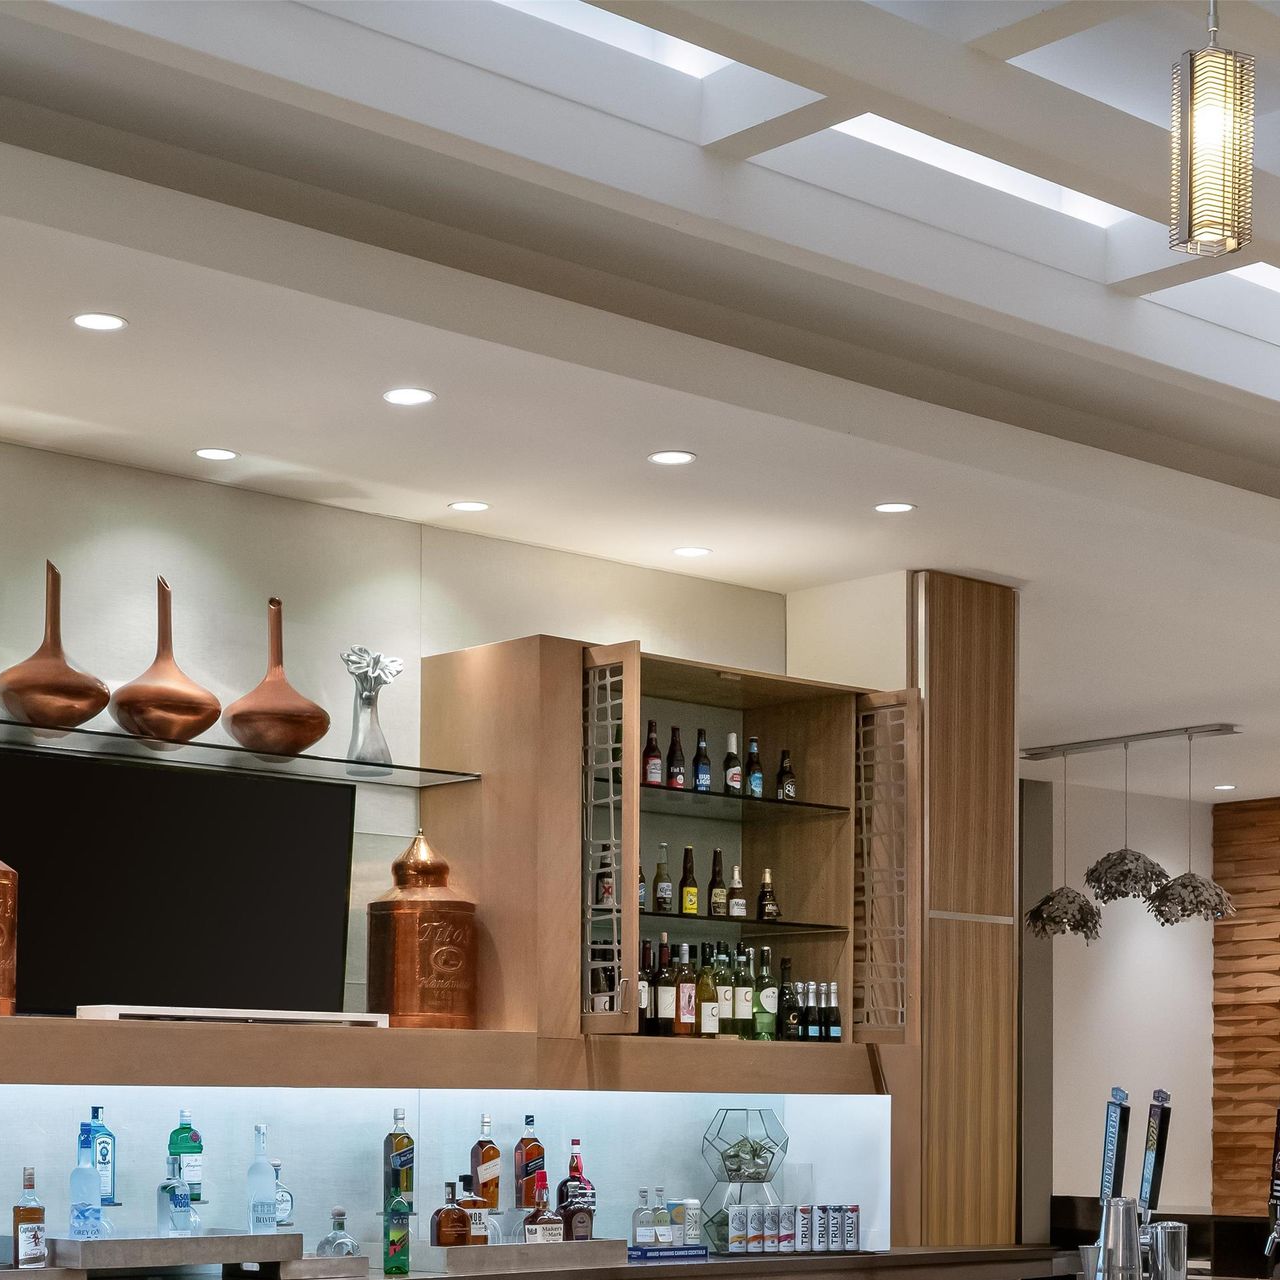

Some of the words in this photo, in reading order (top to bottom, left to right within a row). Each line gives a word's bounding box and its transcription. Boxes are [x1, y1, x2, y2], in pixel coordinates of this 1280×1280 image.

[1106, 1111, 1118, 1159] MEXICAN
[1103, 1160, 1114, 1195] LAGER
[818, 1215, 827, 1246] TRULY
[831, 1214, 839, 1245] TRULY
[846, 1214, 854, 1245] TRULY
